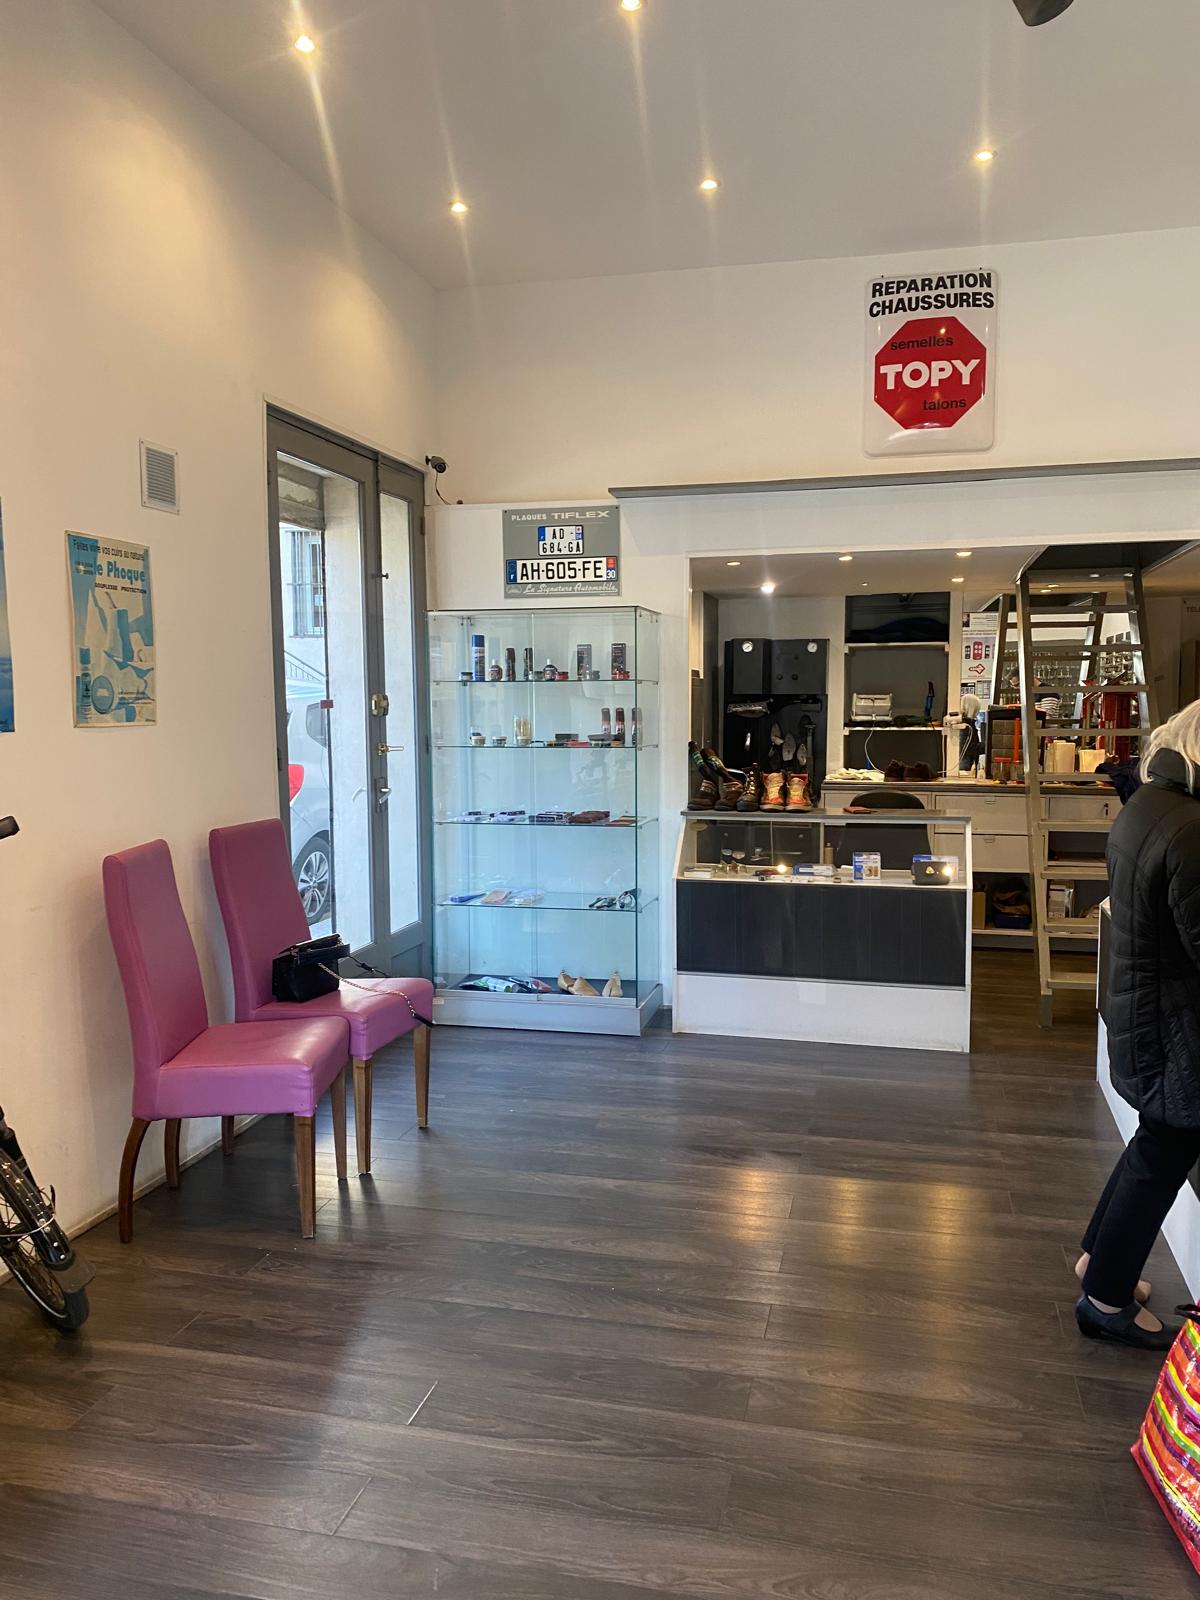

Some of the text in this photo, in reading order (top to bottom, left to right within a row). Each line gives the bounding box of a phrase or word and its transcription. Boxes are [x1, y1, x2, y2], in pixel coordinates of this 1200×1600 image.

[871, 272, 992, 298] REPARATION
[869, 291, 994, 318] CHAUSSURES
[890, 335, 954, 351] semelles
[879, 358, 981, 390] TOPY
[923, 398, 967, 411] talons
[511, 510, 610, 521] PLAQUES TIFLEX
[106, 560, 146, 585] Phoque
[520, 560, 603, 581] AH-605-FE
[606, 569, 616, 579] 30
[573, 581, 618, 594] Automobile
